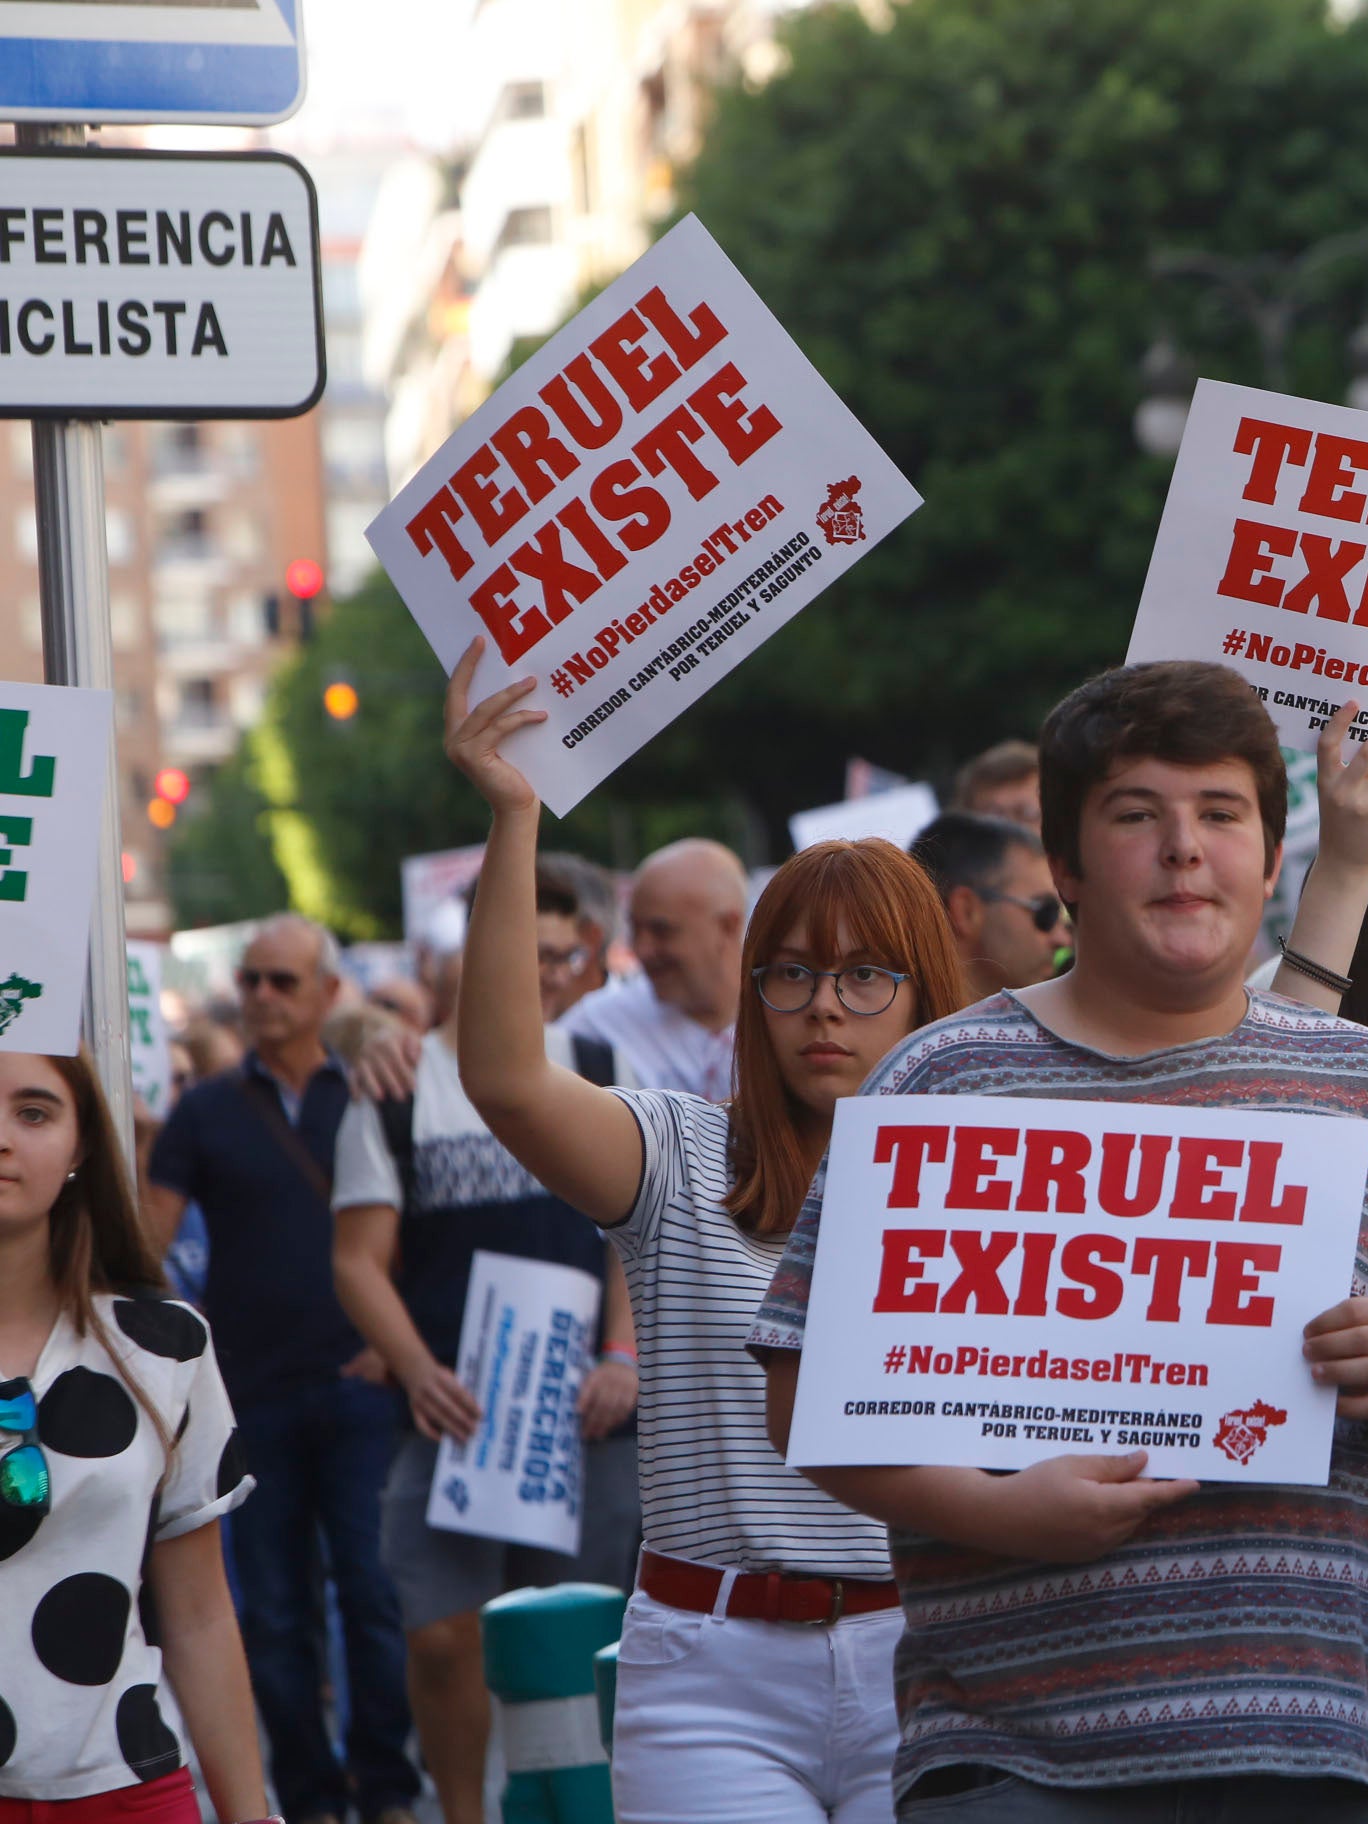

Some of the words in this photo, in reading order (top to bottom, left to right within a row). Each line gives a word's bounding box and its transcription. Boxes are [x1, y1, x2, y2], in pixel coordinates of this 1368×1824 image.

[405, 285, 729, 582] TERUEL
[467, 361, 783, 666] EXISTE
[550, 494, 785, 698] #NoPierdaselTren
[562, 687, 632, 750] CORREDOR
[628, 531, 810, 692] CANTÁBRICO-MEDITERRÁNEO
[668, 653, 701, 683] POR
[696, 610, 752, 658] TERUEL
[746, 598, 762, 614] Y
[759, 545, 823, 604] SAGUNTO
[873, 1125, 1308, 1226] TERUEL
[872, 1229, 1282, 1327] EXISTE
[518, 1308, 573, 1505] DERECHOS
[844, 1401, 936, 1416] CORREDOR
[941, 1400, 1203, 1429] CANTÁBRICO-MEDITERRÁNEO
[883, 1344, 1209, 1387] #NoPierdaselTren
[981, 1422, 1017, 1438] POR
[1023, 1425, 1094, 1443] TERUEL
[1099, 1428, 1111, 1444] Y
[1117, 1429, 1201, 1448] SAGUNTO
